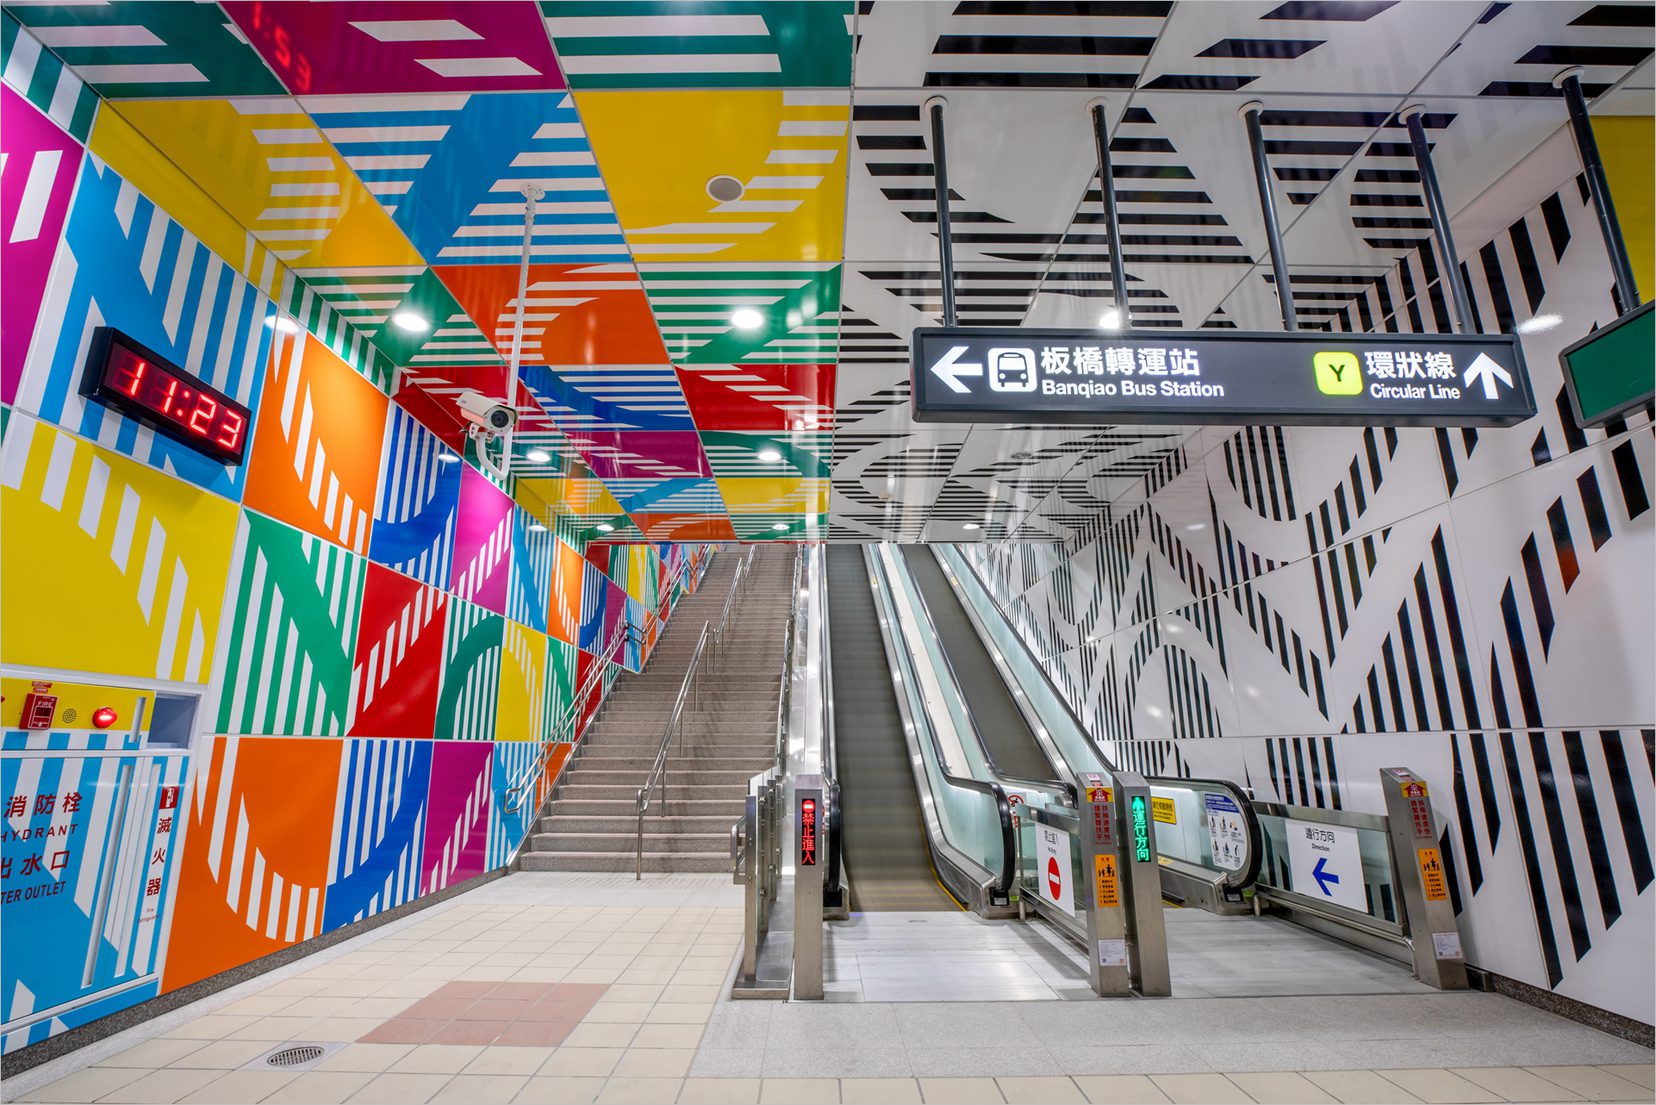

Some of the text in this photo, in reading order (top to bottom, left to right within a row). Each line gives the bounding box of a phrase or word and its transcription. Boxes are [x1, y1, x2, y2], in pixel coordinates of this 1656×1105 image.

[1040, 346, 1201, 376] 板橋轉運站
[1328, 363, 1346, 383] Y
[1363, 351, 1457, 379] 環狀線
[1042, 379, 1225, 399] Banqiao Bus Station
[1370, 383, 1461, 399] Circular Line
[128, 360, 243, 450] 11:23
[3, 791, 83, 819] 消防栓
[1, 823, 79, 843] HYDRANT
[801, 812, 816, 865] 禁止進入
[1, 850, 70, 879] 出水口
[146, 817, 173, 897] 滅火器
[24, 880, 67, 901] OUTLET
